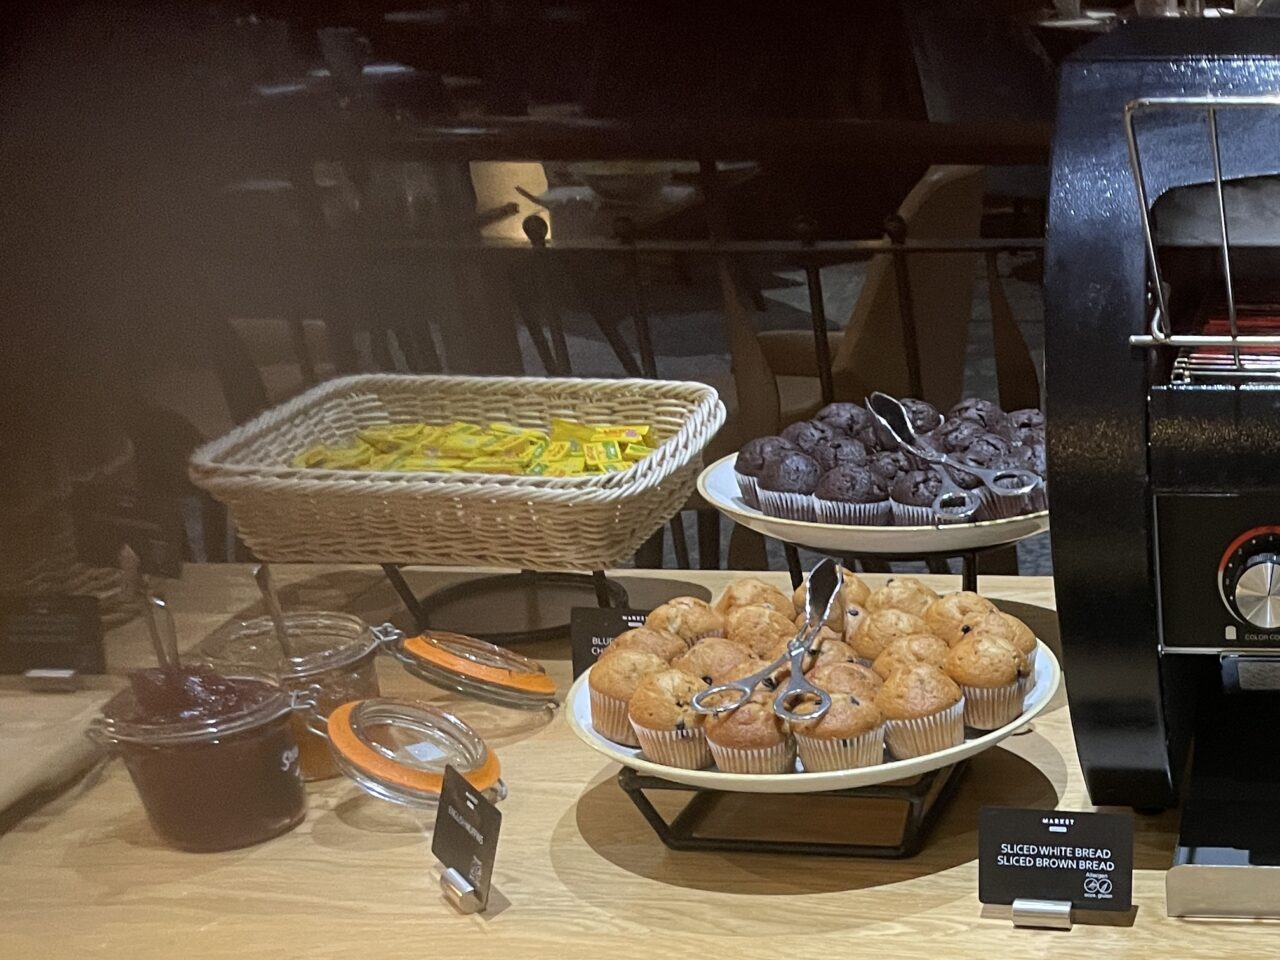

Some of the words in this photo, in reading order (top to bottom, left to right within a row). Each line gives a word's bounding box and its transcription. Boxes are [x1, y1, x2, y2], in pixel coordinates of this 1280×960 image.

[1042, 817, 1075, 826] MARKET
[1001, 843, 1038, 855] SLICED
[1039, 846, 1073, 857] WHITE
[1075, 847, 1111, 859] BREAD
[997, 855, 1034, 867] SLICED
[1035, 858, 1077, 869] BROWN
[1079, 860, 1115, 871] BREAD
